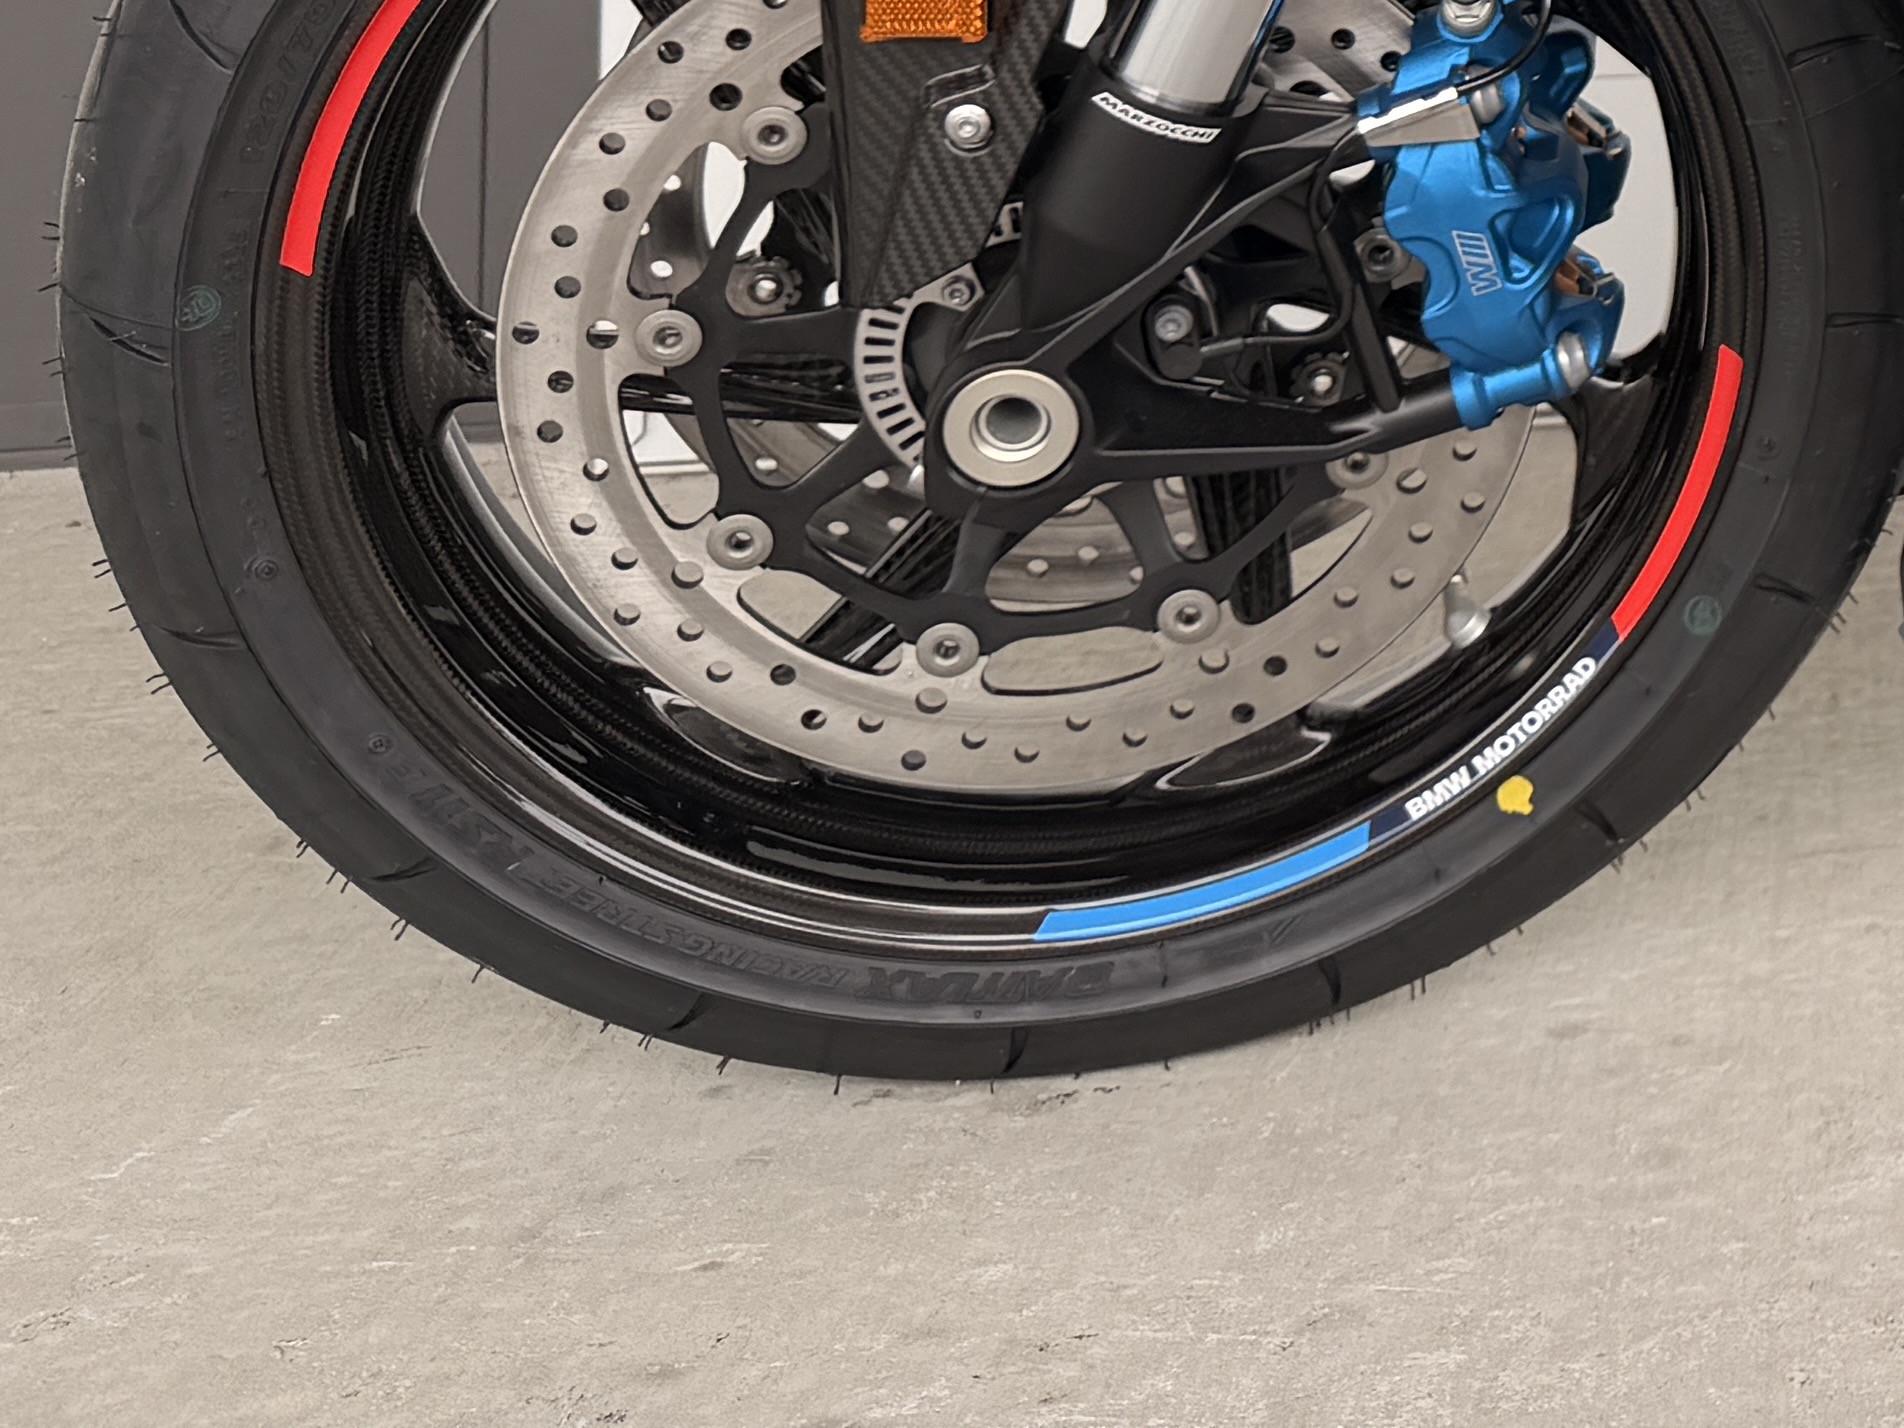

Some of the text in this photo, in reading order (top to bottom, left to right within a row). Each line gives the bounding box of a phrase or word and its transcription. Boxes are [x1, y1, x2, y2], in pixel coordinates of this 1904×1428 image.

[1099, 96, 1214, 140] MARZOCCHI
[1404, 656, 1597, 821] BMW MOTORRAD
